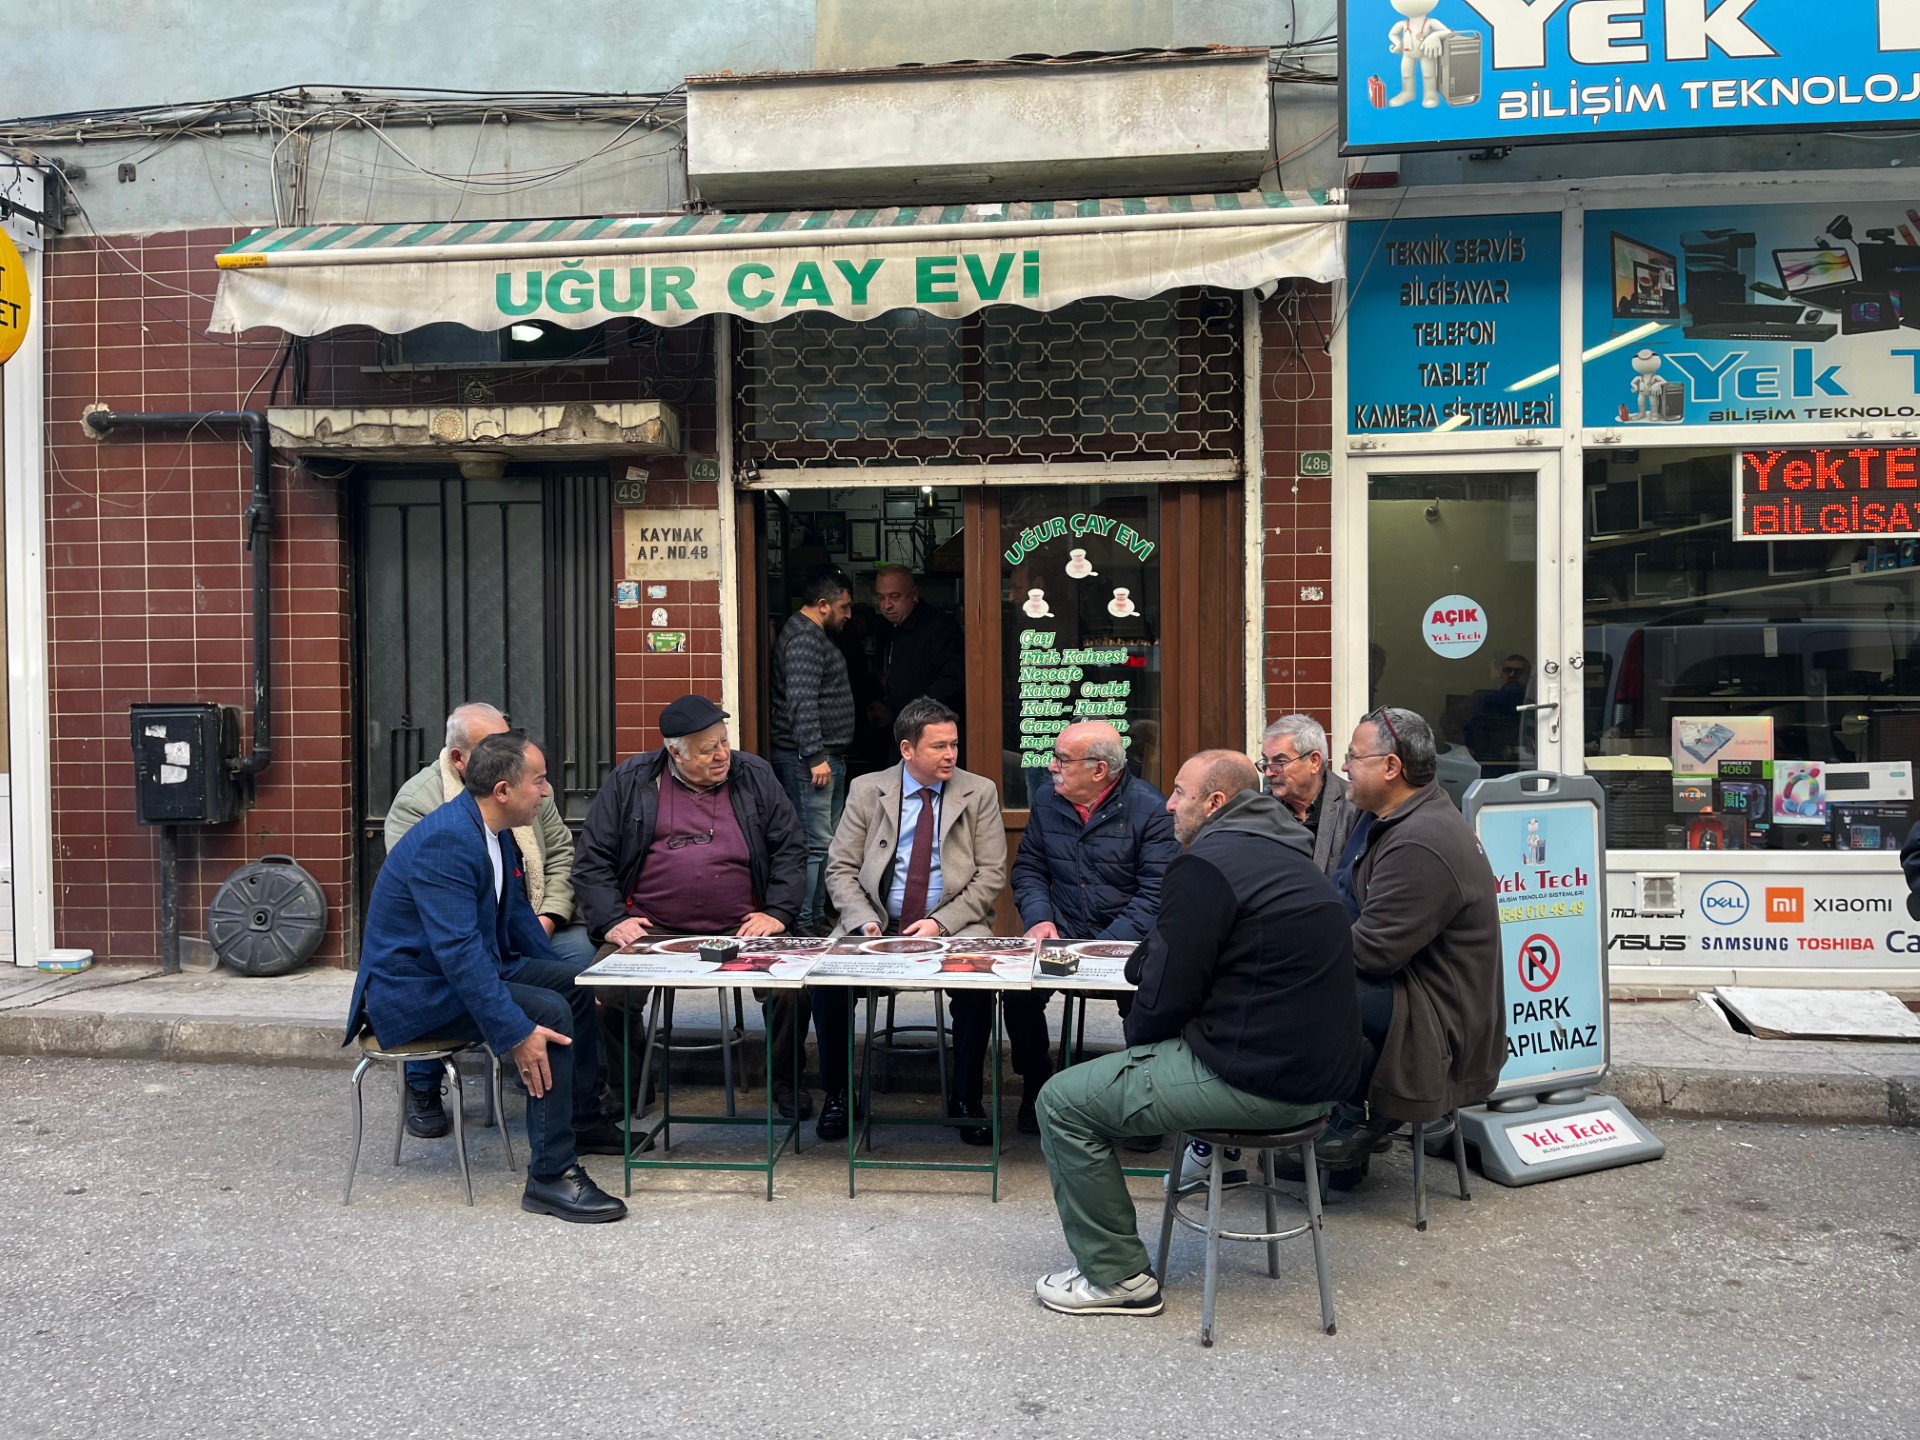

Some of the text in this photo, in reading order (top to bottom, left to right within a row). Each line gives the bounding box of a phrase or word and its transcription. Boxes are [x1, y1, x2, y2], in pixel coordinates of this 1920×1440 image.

[1498, 76, 1667, 125] BİLİŞİM
[1386, 231, 1525, 266] TEKNİK SERVİS
[495, 259, 700, 316] UĞUR
[915, 249, 1040, 304] EVİ
[1400, 274, 1510, 307] BİLGİSAYAR
[1413, 320, 1496, 347] TELEFON
[1418, 362, 1490, 387] TABLET
[1355, 393, 1554, 428] KAMERA SİSTEMLERİ
[1708, 406, 1796, 423] BİLİŞİM
[1304, 457, 1329, 470] 48B
[619, 483, 641, 499] 48
[1753, 496, 1920, 534] BİLGİSA
[640, 528, 704, 542] KAYNAK
[1004, 513, 1155, 565] UĞUR ÇAY EVİ
[1431, 608, 1478, 627] AÇIK
[1020, 629, 1056, 649] Çay
[1020, 647, 1129, 666] Türk Kahvesi
[1018, 665, 1083, 684] Nescafe
[1019, 681, 1130, 699] Kakao Oralet
[1073, 698, 1127, 716] Fanta
[1721, 766, 1750, 774] 4060
[1706, 897, 1745, 909] DELL
[1814, 897, 1892, 912] xiaomi
[1608, 934, 1687, 951] ASUS
[1701, 937, 1789, 950] SAMSUNG
[1797, 938, 1875, 950] TOSHIBA
[1513, 996, 1571, 1025] PARK
[1505, 1024, 1598, 1058] APILMAZ
